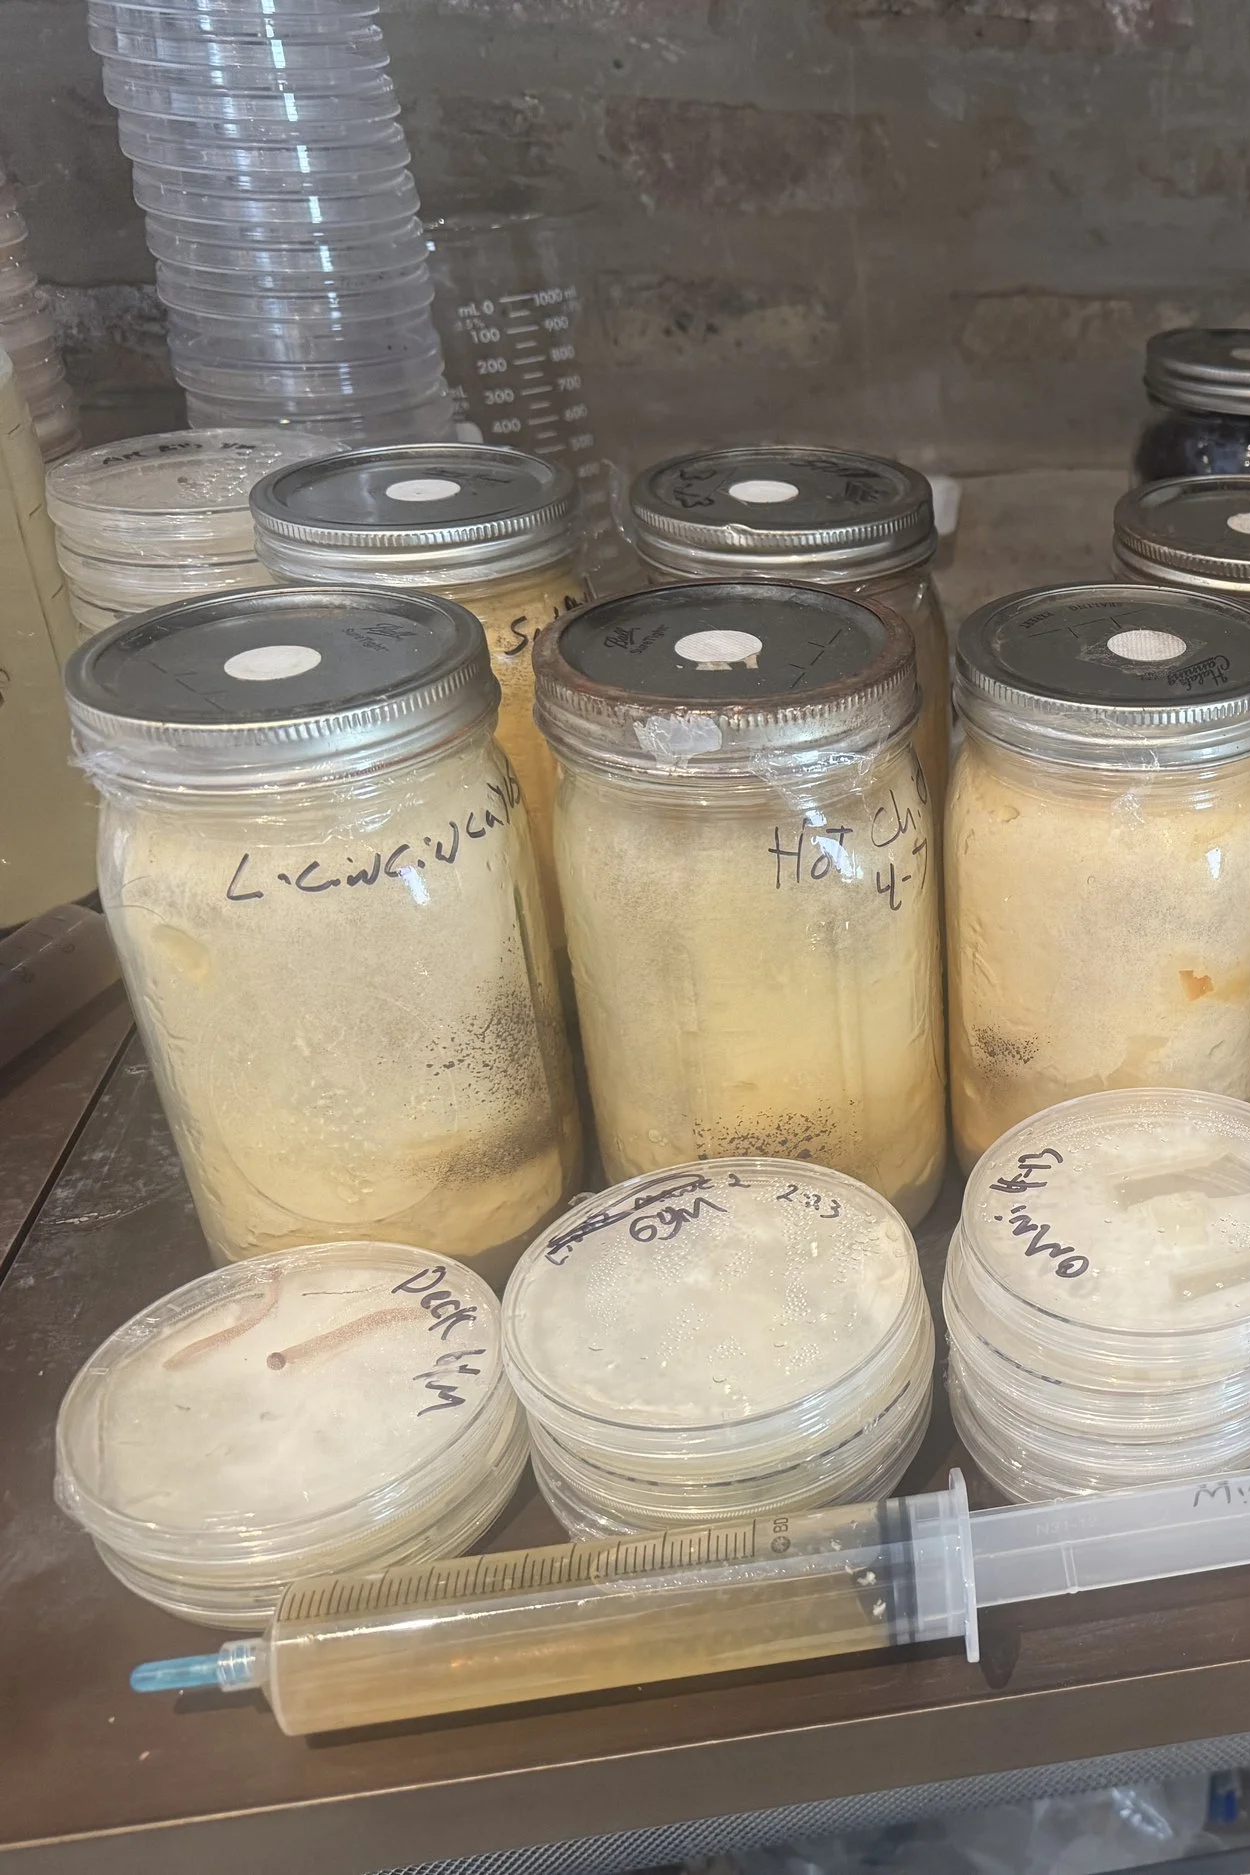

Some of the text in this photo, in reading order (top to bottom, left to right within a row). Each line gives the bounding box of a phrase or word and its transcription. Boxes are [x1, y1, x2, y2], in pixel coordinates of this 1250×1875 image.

[470, 328, 501, 344] 100
[477, 358, 508, 375] 200
[484, 388, 515, 405] 300
[491, 418, 522, 434] 400
[772, 1517, 789, 1534] BD
